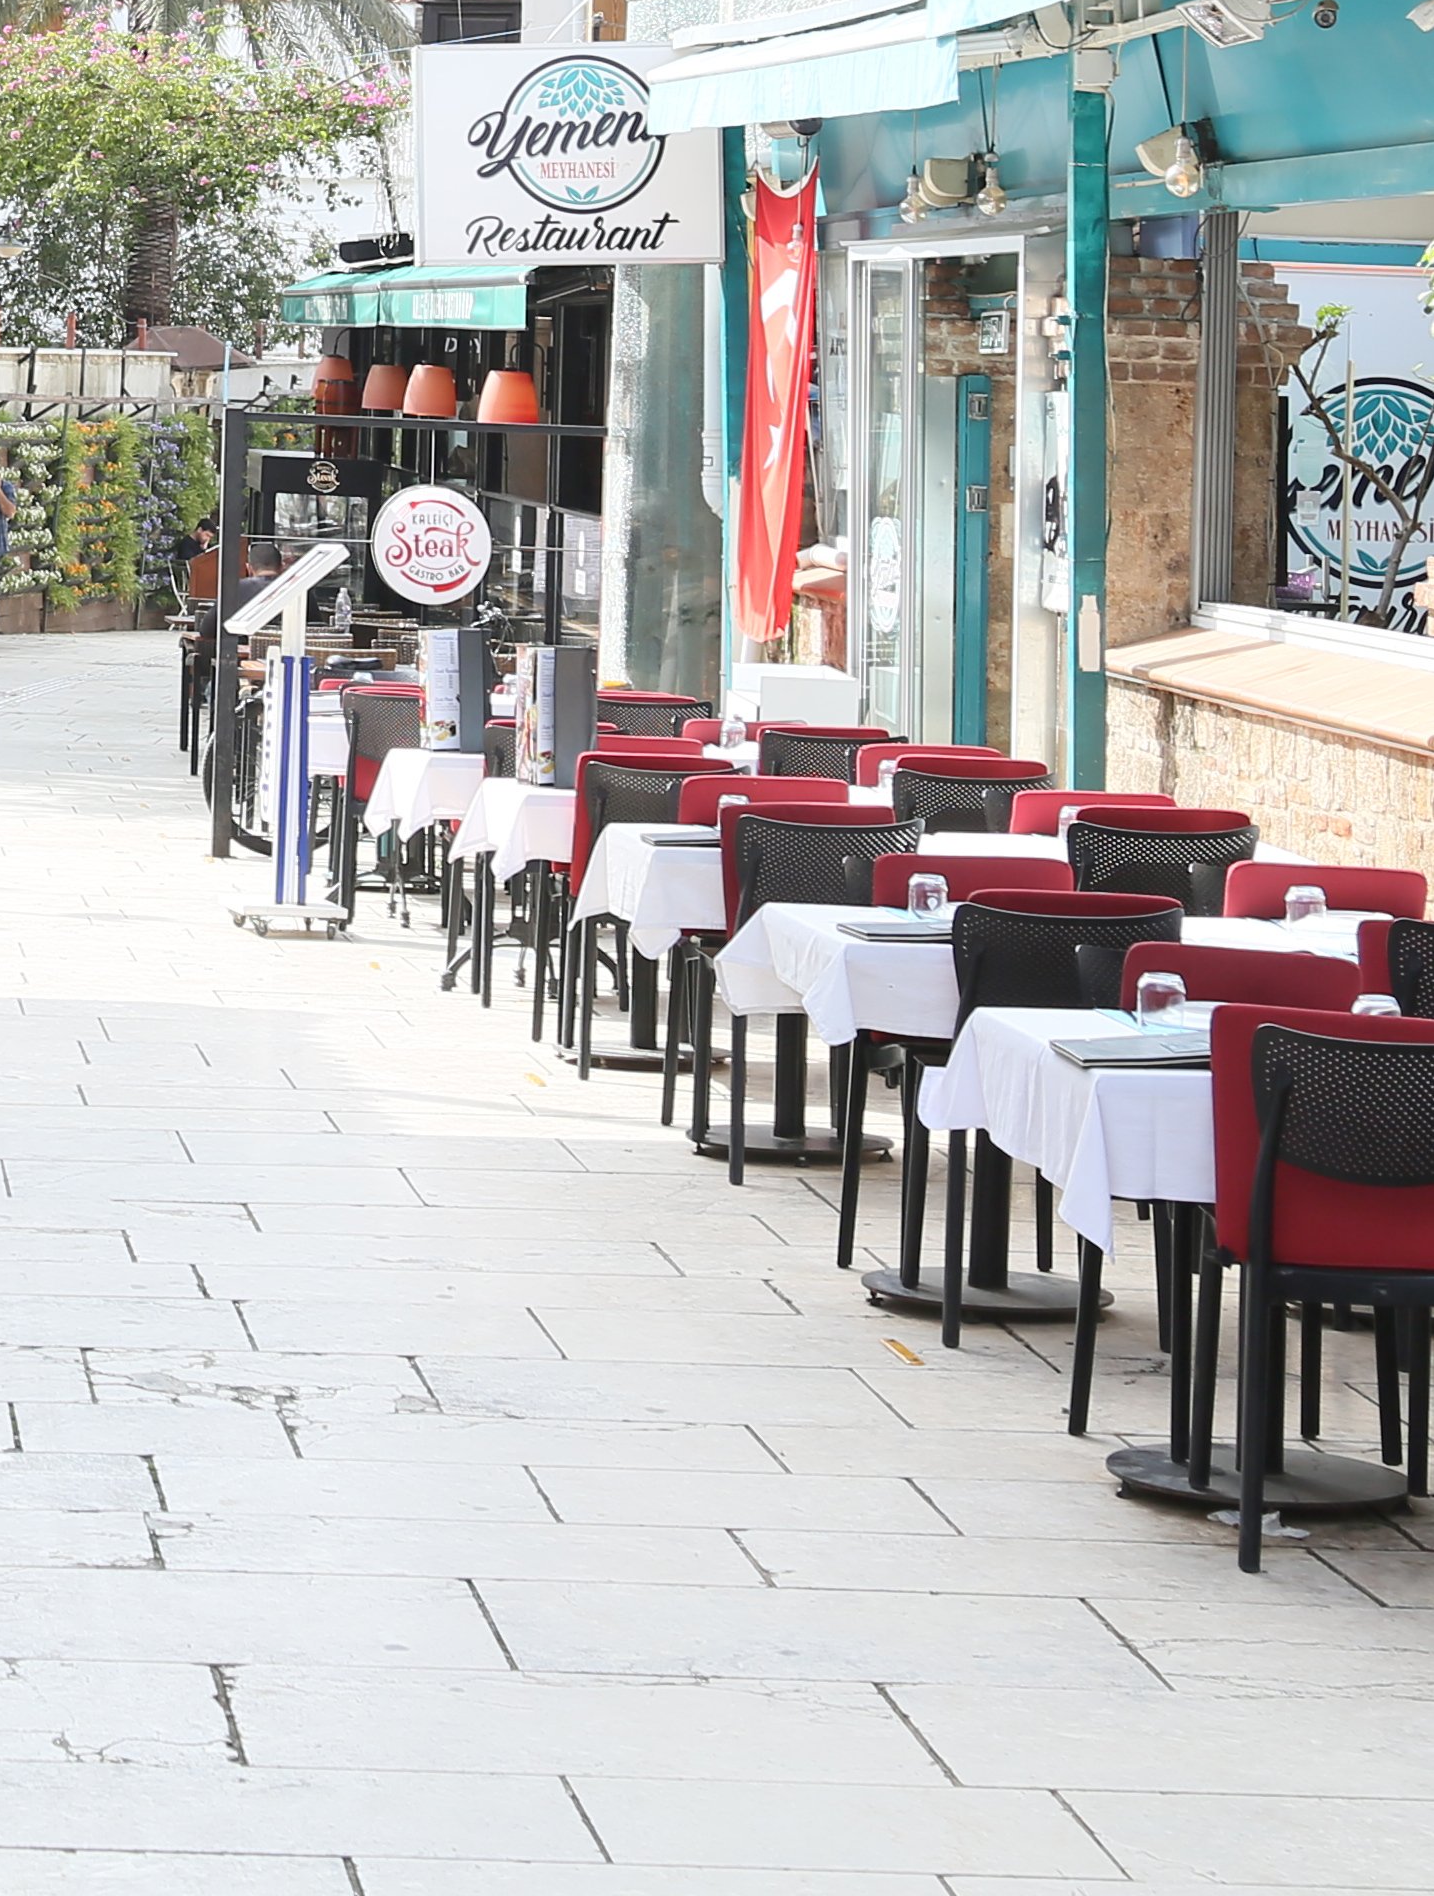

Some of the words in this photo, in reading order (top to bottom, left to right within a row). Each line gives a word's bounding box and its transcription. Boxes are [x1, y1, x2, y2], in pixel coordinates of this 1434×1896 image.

[540, 157, 616, 179] MEYHANESİ
[465, 212, 680, 257] Restaurant
[412, 510, 453, 527] KALEİÇİ
[385, 521, 482, 568] Steak
[408, 565, 444, 581] GASTRO
[448, 564, 466, 578] BAR
